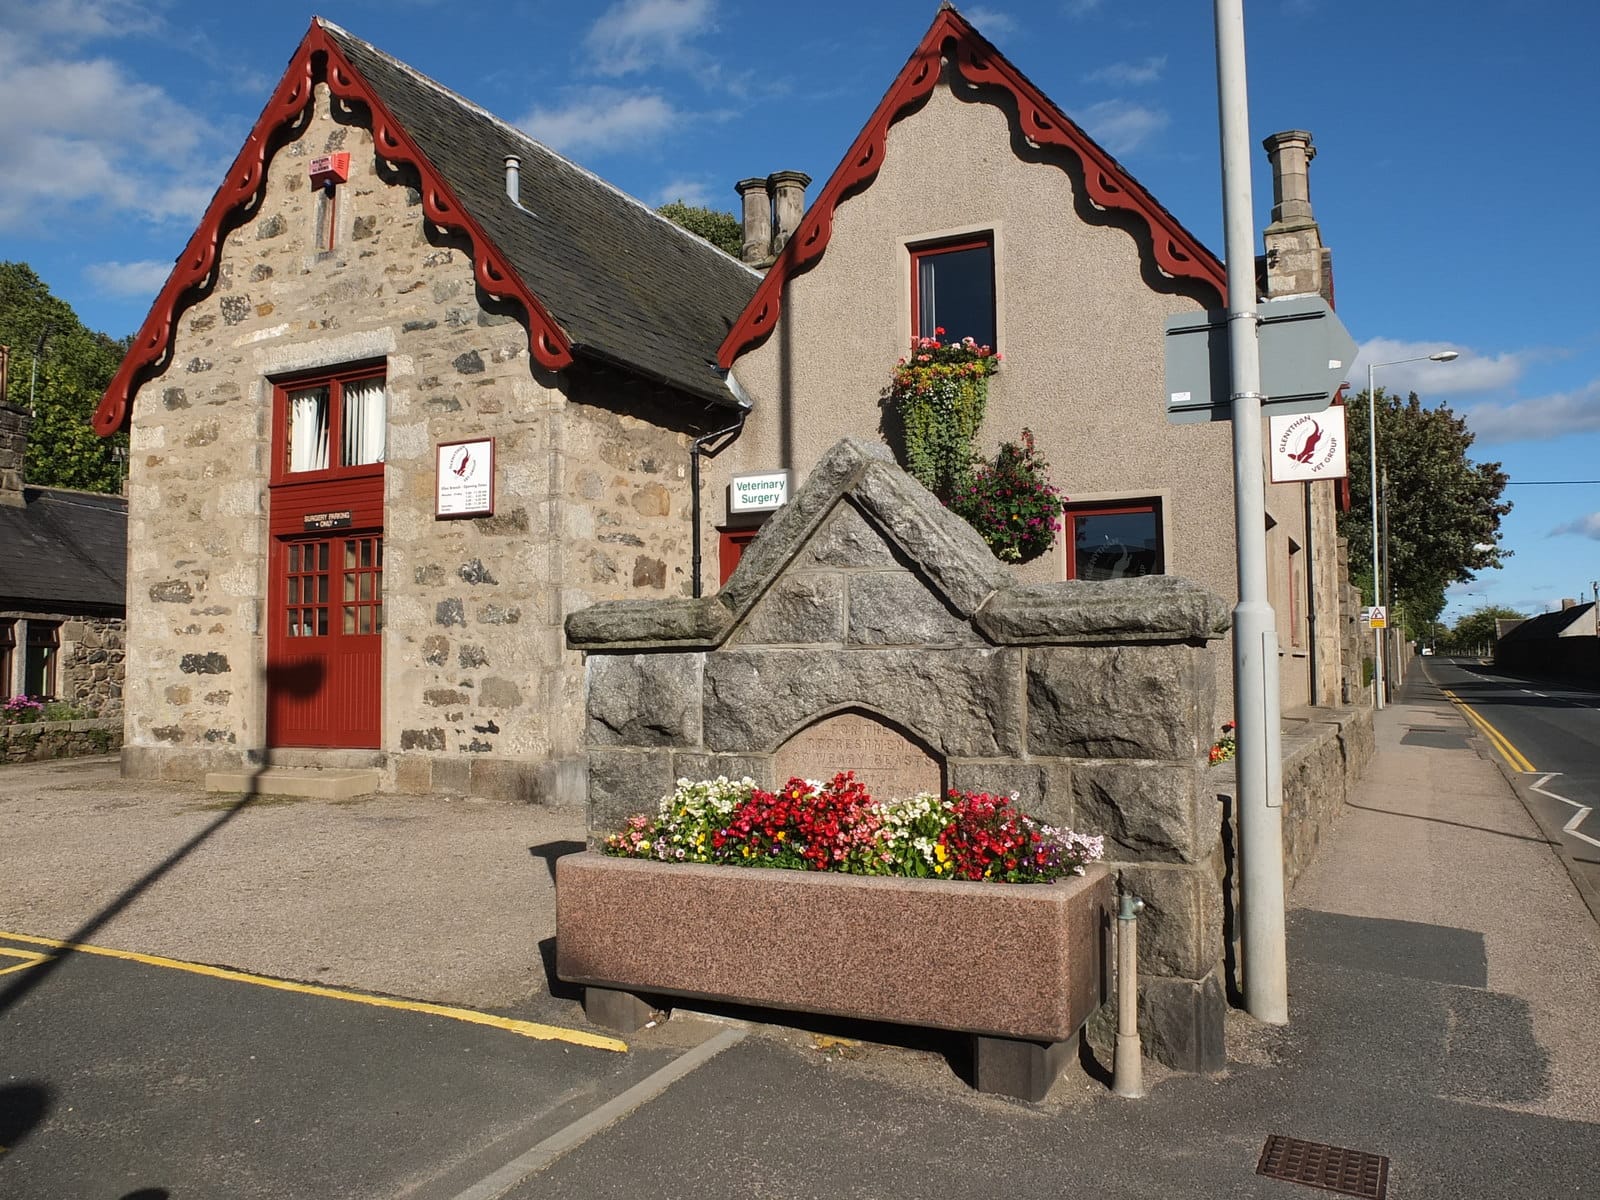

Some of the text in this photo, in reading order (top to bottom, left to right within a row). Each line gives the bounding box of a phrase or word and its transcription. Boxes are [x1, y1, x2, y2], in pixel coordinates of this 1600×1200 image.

[1279, 414, 1312, 453] GLENYTHAN
[1311, 437, 1338, 473] VET GROUP
[736, 480, 785, 491] Veterinary
[741, 493, 780, 505] Surgery
[319, 520, 334, 528] ONLY
[832, 724, 889, 735] FOR THE
[816, 752, 865, 765] WEARY
[874, 754, 933, 767] BEASTS
